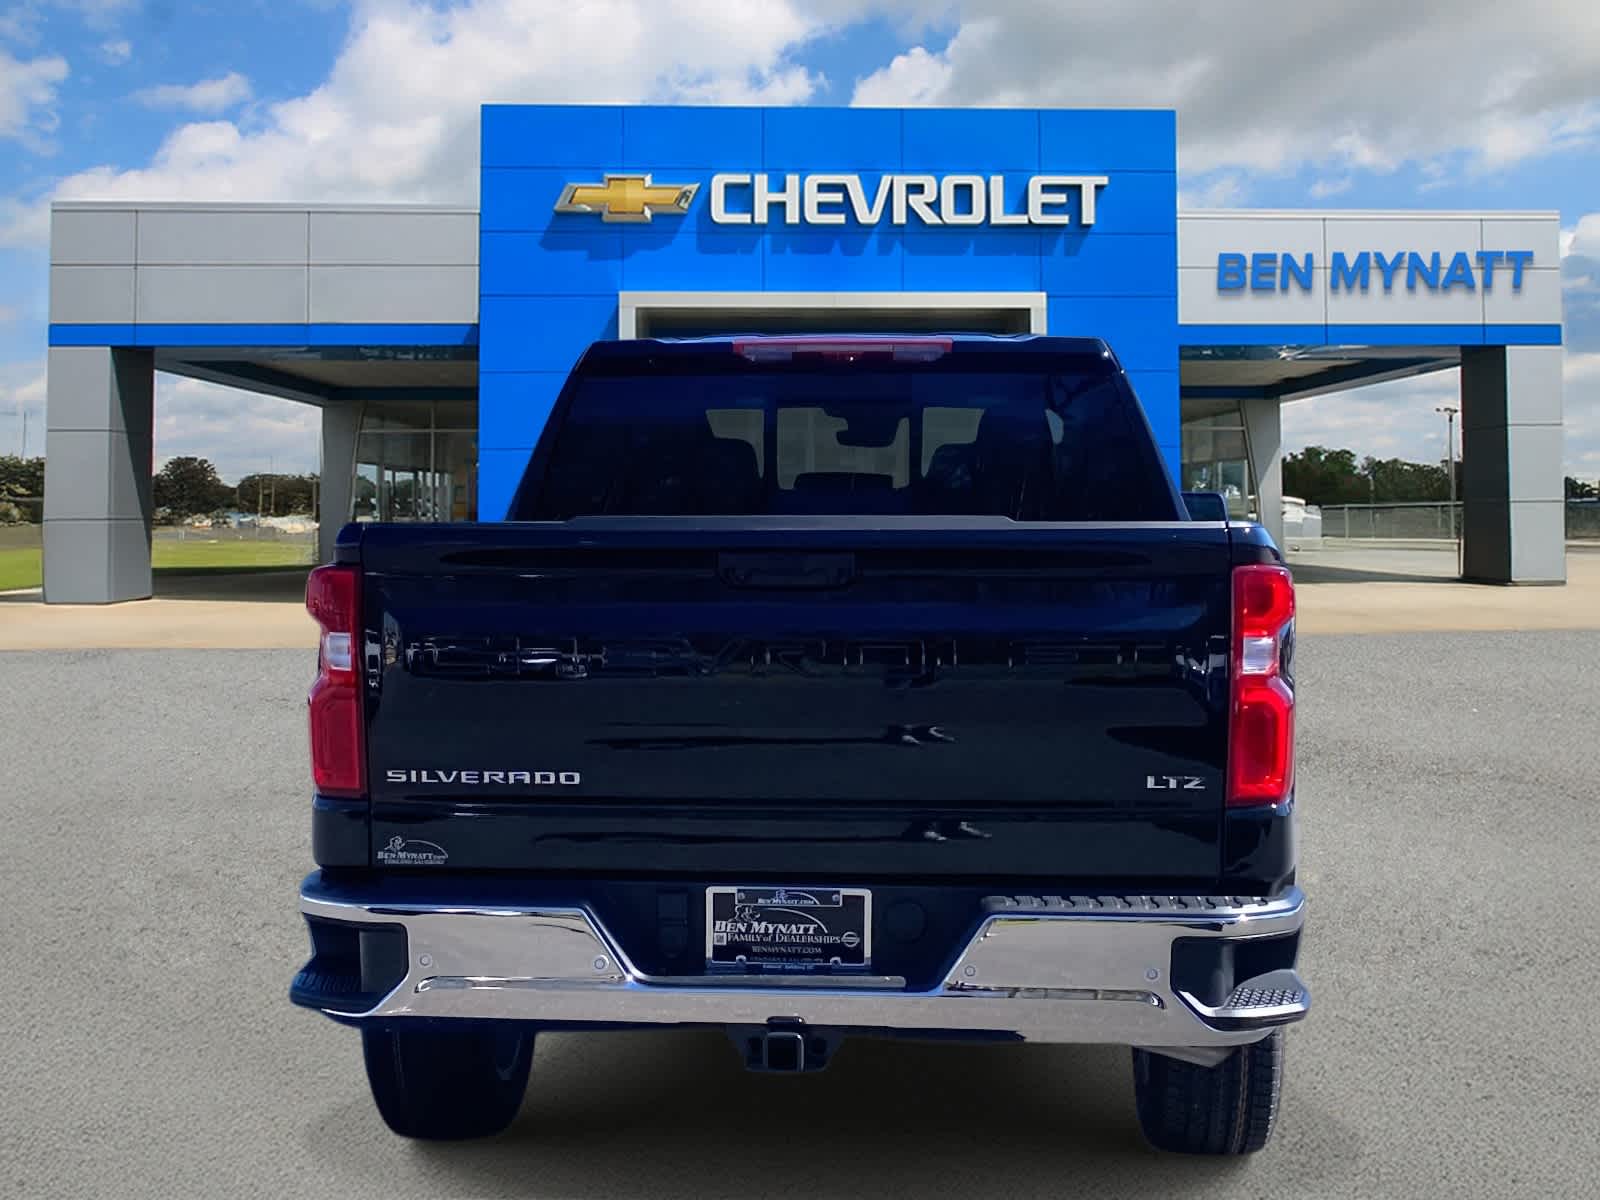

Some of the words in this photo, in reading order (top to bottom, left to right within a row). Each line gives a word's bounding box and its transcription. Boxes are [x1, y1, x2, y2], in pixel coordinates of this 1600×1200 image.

[710, 173, 1109, 226] CHEVROLET
[1217, 252, 1314, 291] BEN
[1330, 251, 1534, 292] MYNATT
[386, 769, 581, 785] SILVERADO
[1146, 775, 1206, 789] LTZ
[714, 920, 747, 933] BEN
[750, 921, 818, 935] MYNATT
[727, 932, 761, 942] FAMILY
[775, 932, 841, 944] DEALERSHIPS
